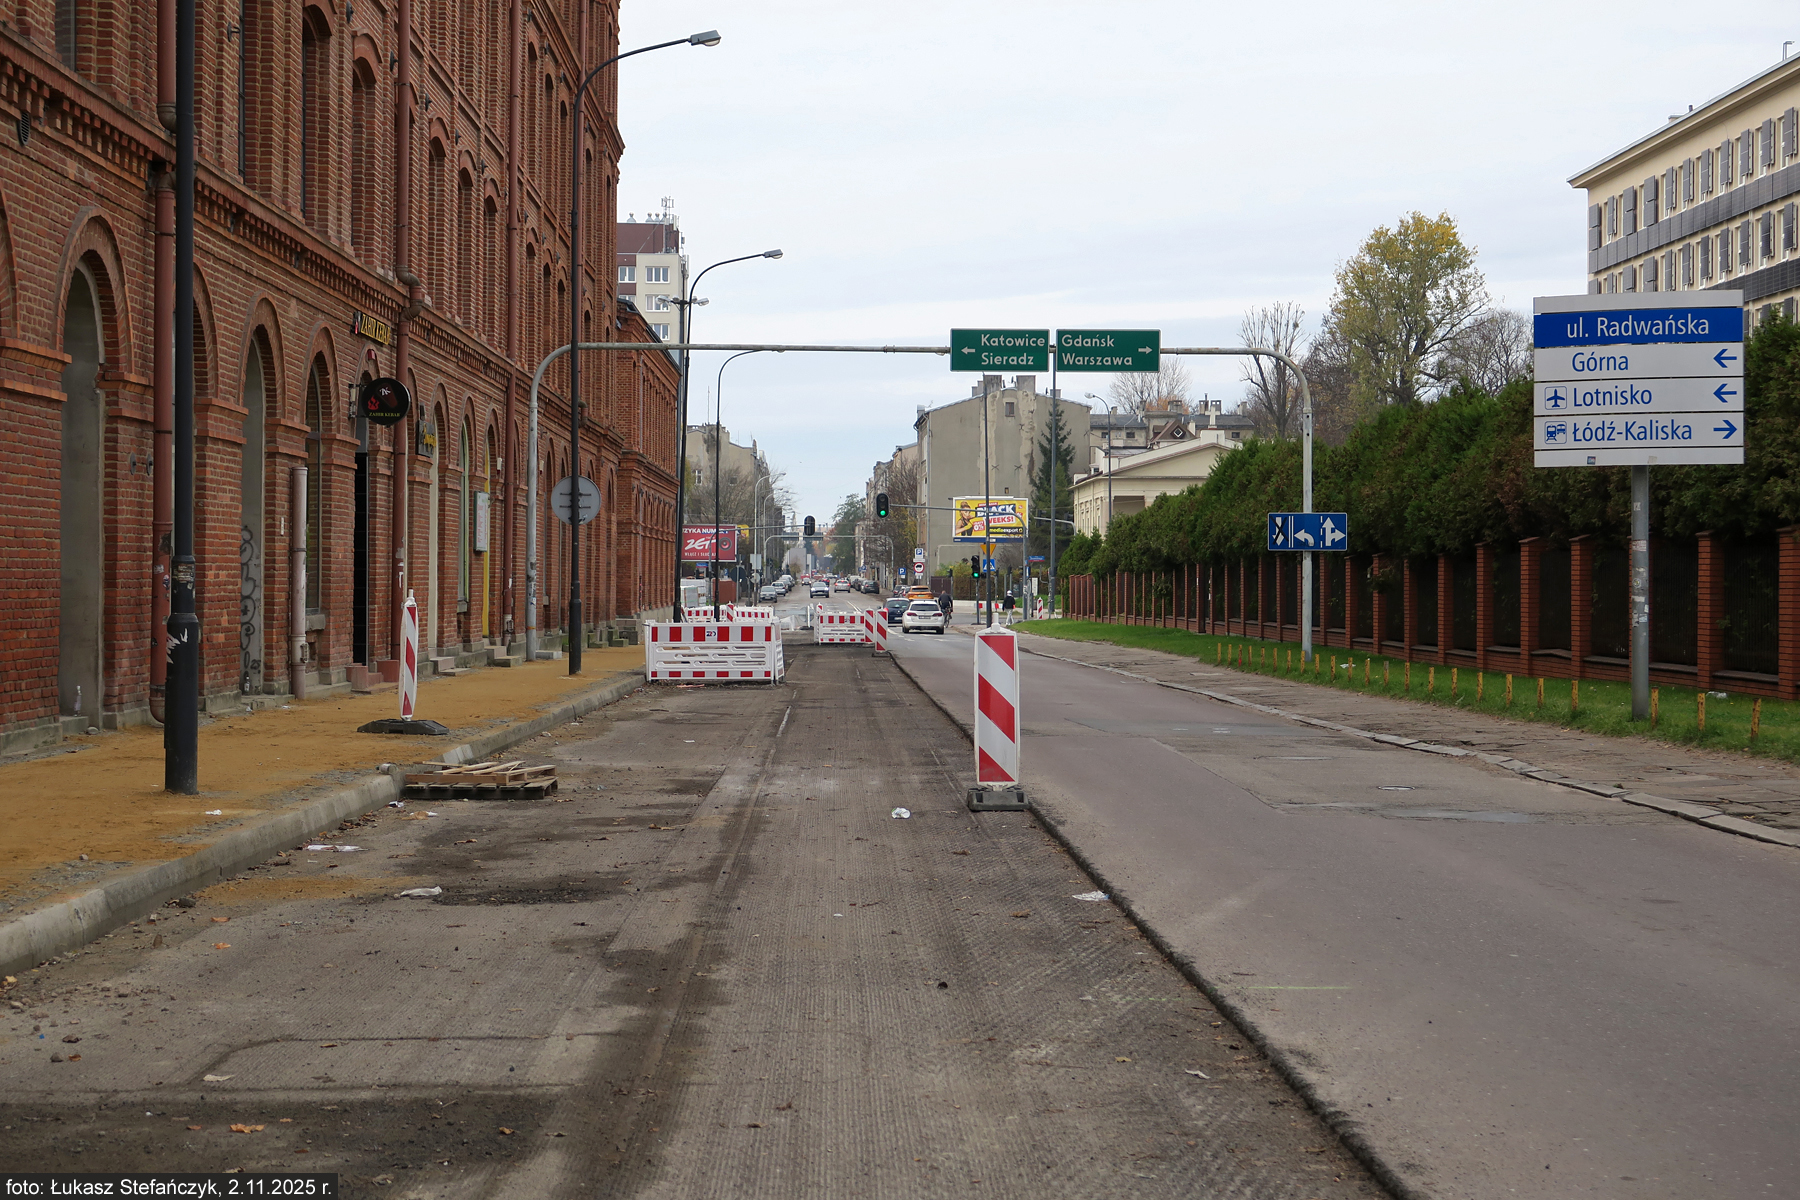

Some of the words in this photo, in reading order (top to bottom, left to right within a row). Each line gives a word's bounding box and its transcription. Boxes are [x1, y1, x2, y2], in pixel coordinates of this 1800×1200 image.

[1567, 317, 1589, 338] ul.
[1597, 313, 1709, 337] Radwańska
[981, 333, 1045, 347] Katowice
[1061, 333, 1115, 347] Gdańsk
[981, 353, 1034, 365] Sieradz
[1062, 353, 1133, 366] Warszawa
[1571, 351, 1629, 372] Górna
[1573, 384, 1652, 407] Lotnisko
[1572, 419, 1692, 442] Łódź-Kaliska
